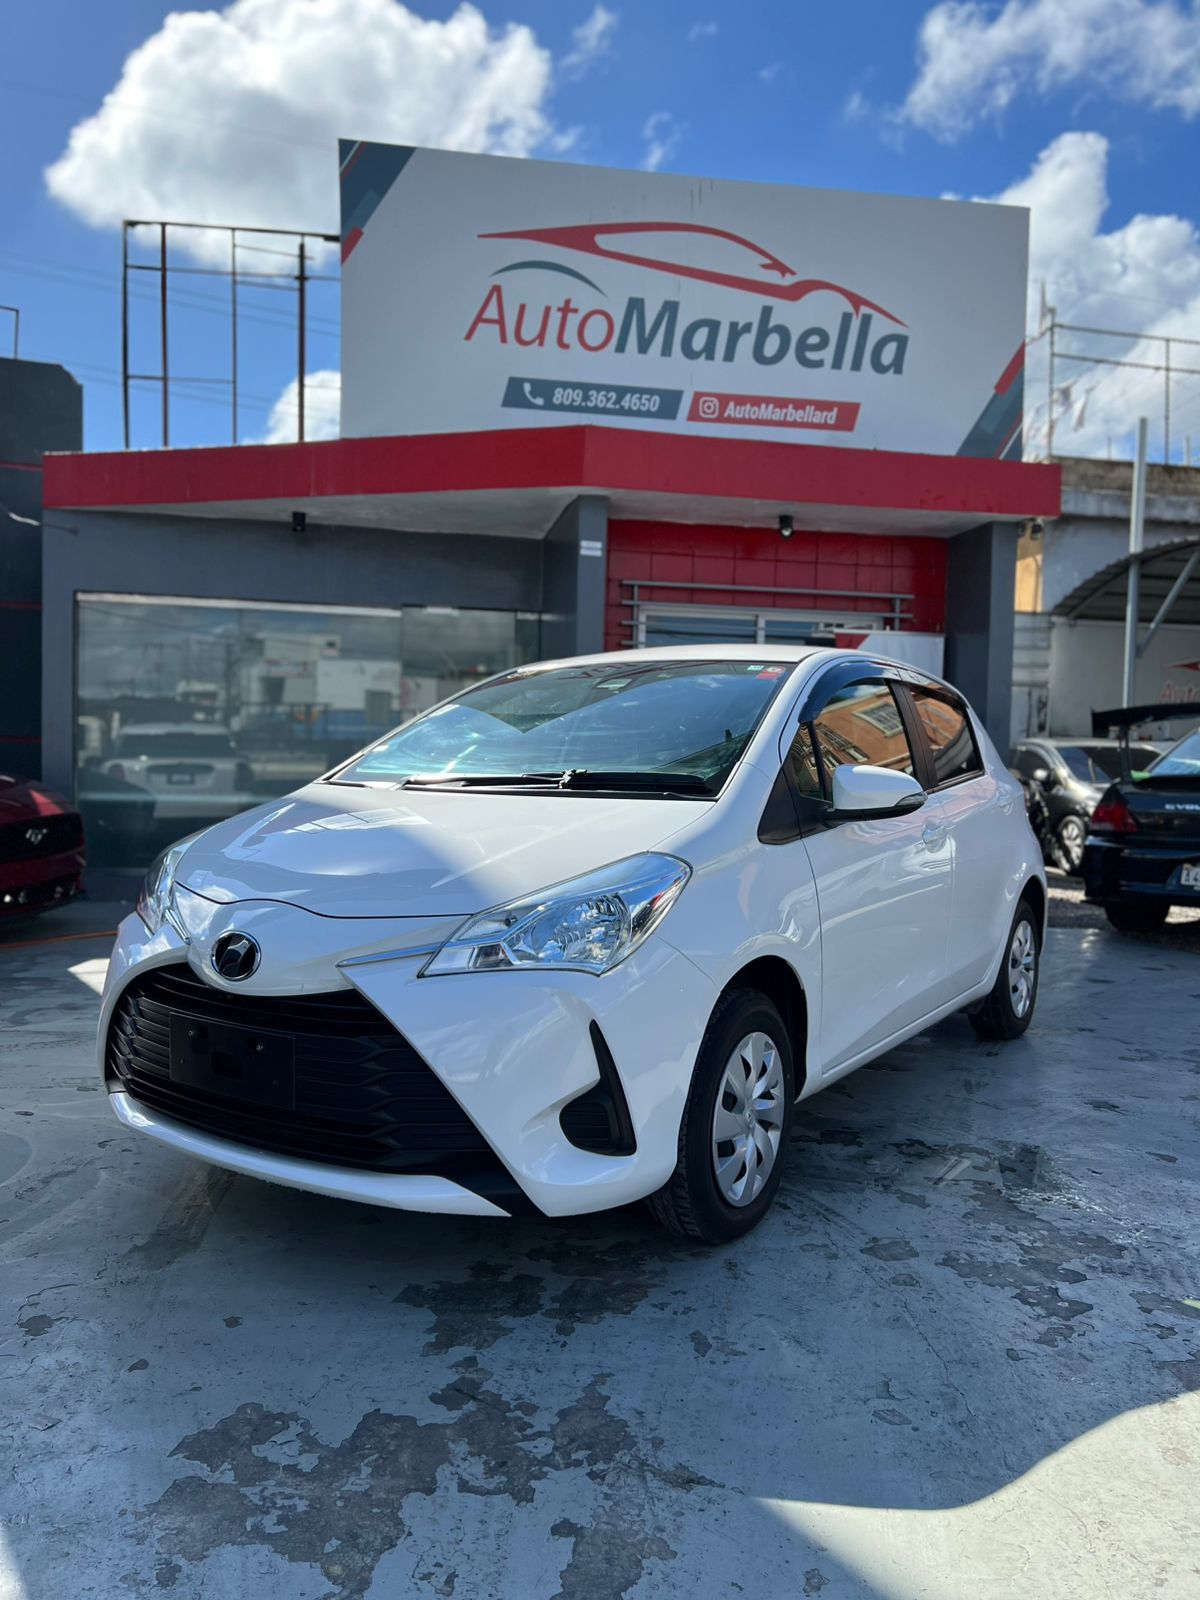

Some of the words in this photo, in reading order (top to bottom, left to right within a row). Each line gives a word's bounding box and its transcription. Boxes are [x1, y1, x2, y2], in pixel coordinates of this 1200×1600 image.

[463, 284, 910, 375] AutoMarbella
[552, 387, 660, 413] 809.362.4650
[723, 400, 837, 425] AutoMarbellard
